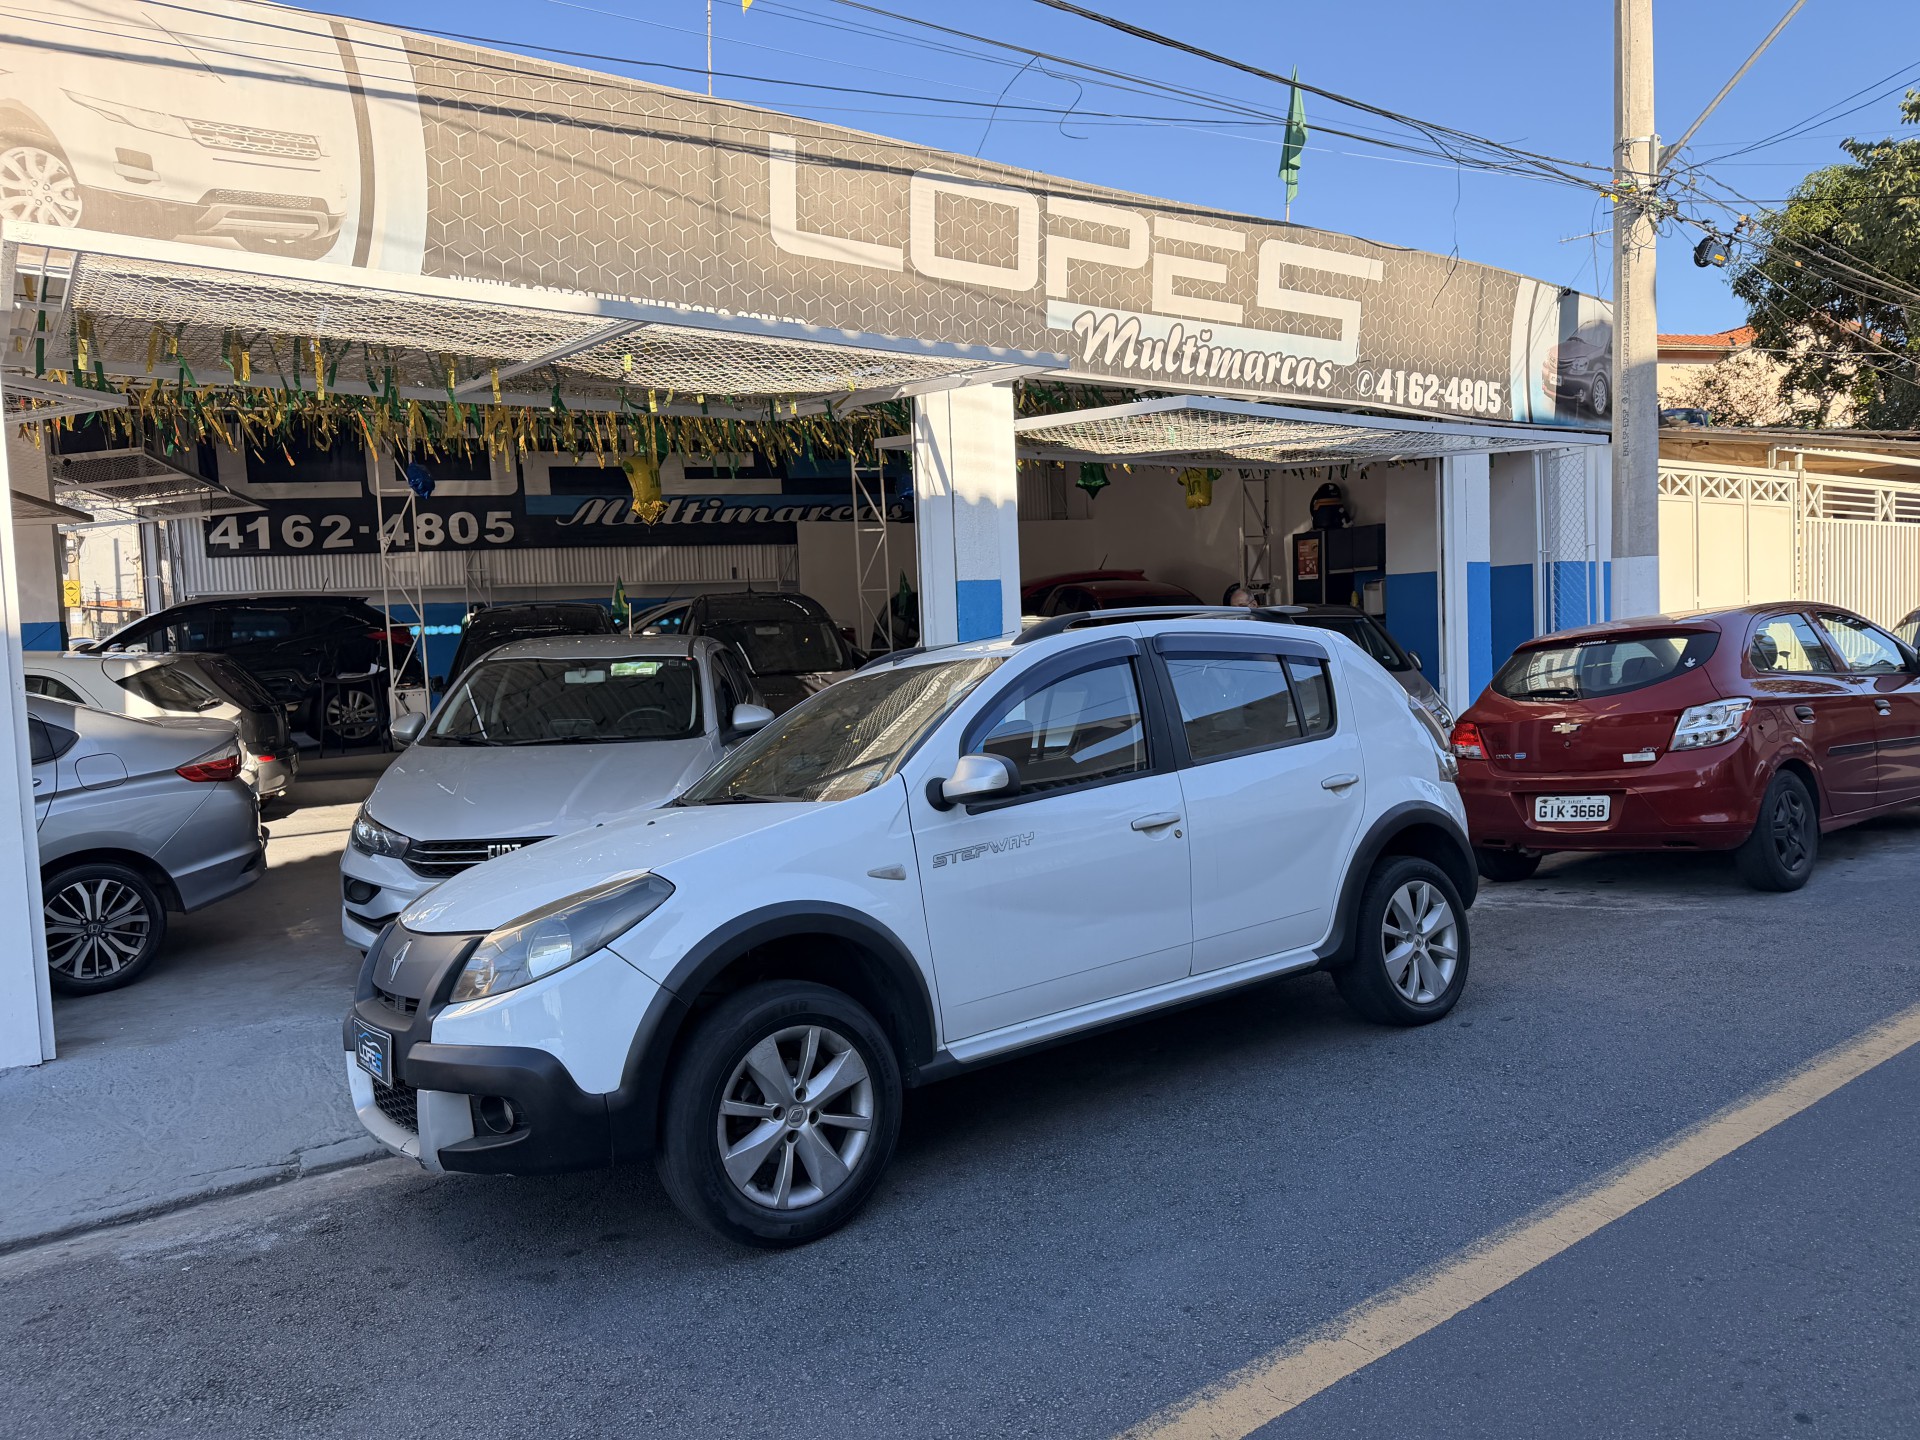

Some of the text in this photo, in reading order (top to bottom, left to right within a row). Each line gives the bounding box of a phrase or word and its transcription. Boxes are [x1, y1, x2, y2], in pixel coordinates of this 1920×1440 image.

[769, 133, 1384, 366] LOPES
[1072, 311, 1333, 390] Multimarcas
[1376, 368, 1501, 413] 4162-4805
[208, 511, 516, 550] 4162-4805
[932, 831, 1035, 869] STEPWAY
